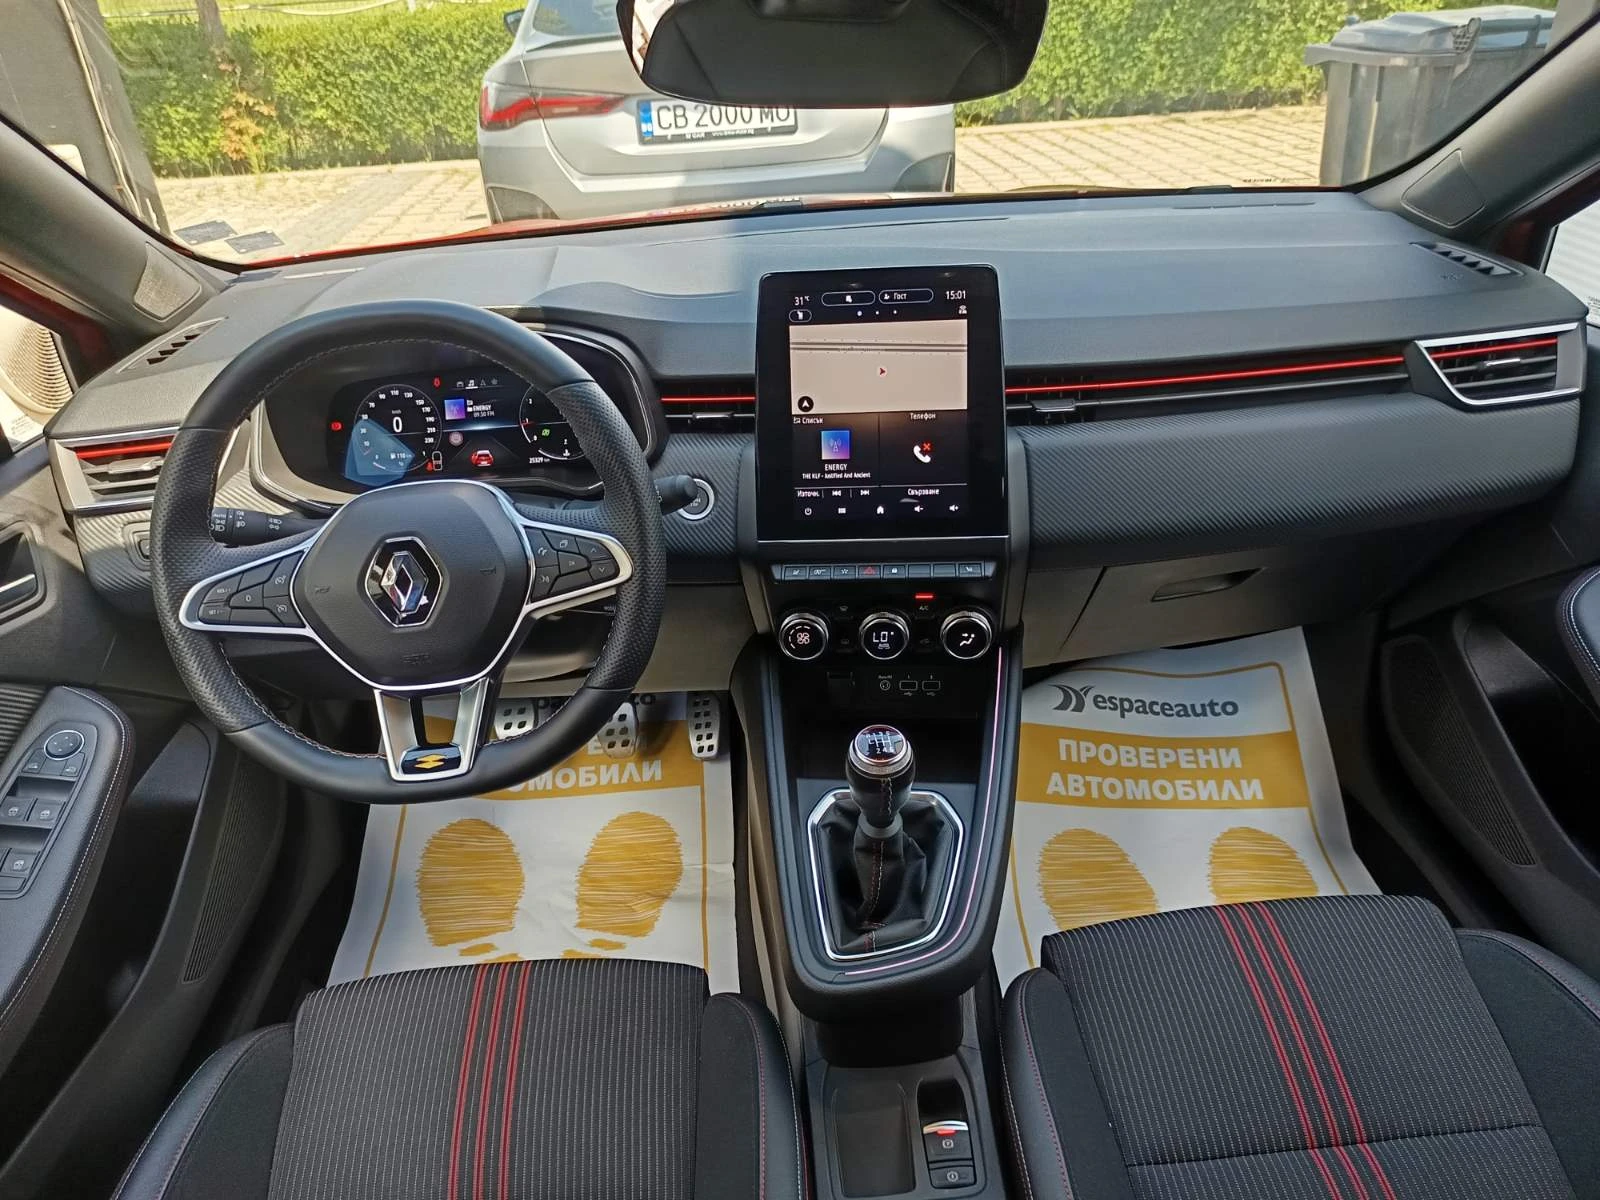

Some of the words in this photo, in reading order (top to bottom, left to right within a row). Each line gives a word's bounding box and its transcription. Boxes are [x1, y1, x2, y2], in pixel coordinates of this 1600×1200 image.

[656, 105, 688, 130] CB
[694, 104, 753, 127] 2000
[795, 296, 804, 305] 31
[893, 292, 907, 300] Гост
[946, 290, 966, 300] 15:01
[473, 404, 492, 412] ENERGY
[910, 412, 936, 420] Телефон
[392, 416, 402, 433] 0
[1092, 691, 1239, 719] espaceauto
[1057, 738, 1243, 769] ПРОВЕРЕНИ
[507, 759, 663, 794] МОБИЛИ
[1046, 771, 1265, 801] АВТОМОБИЛИ
